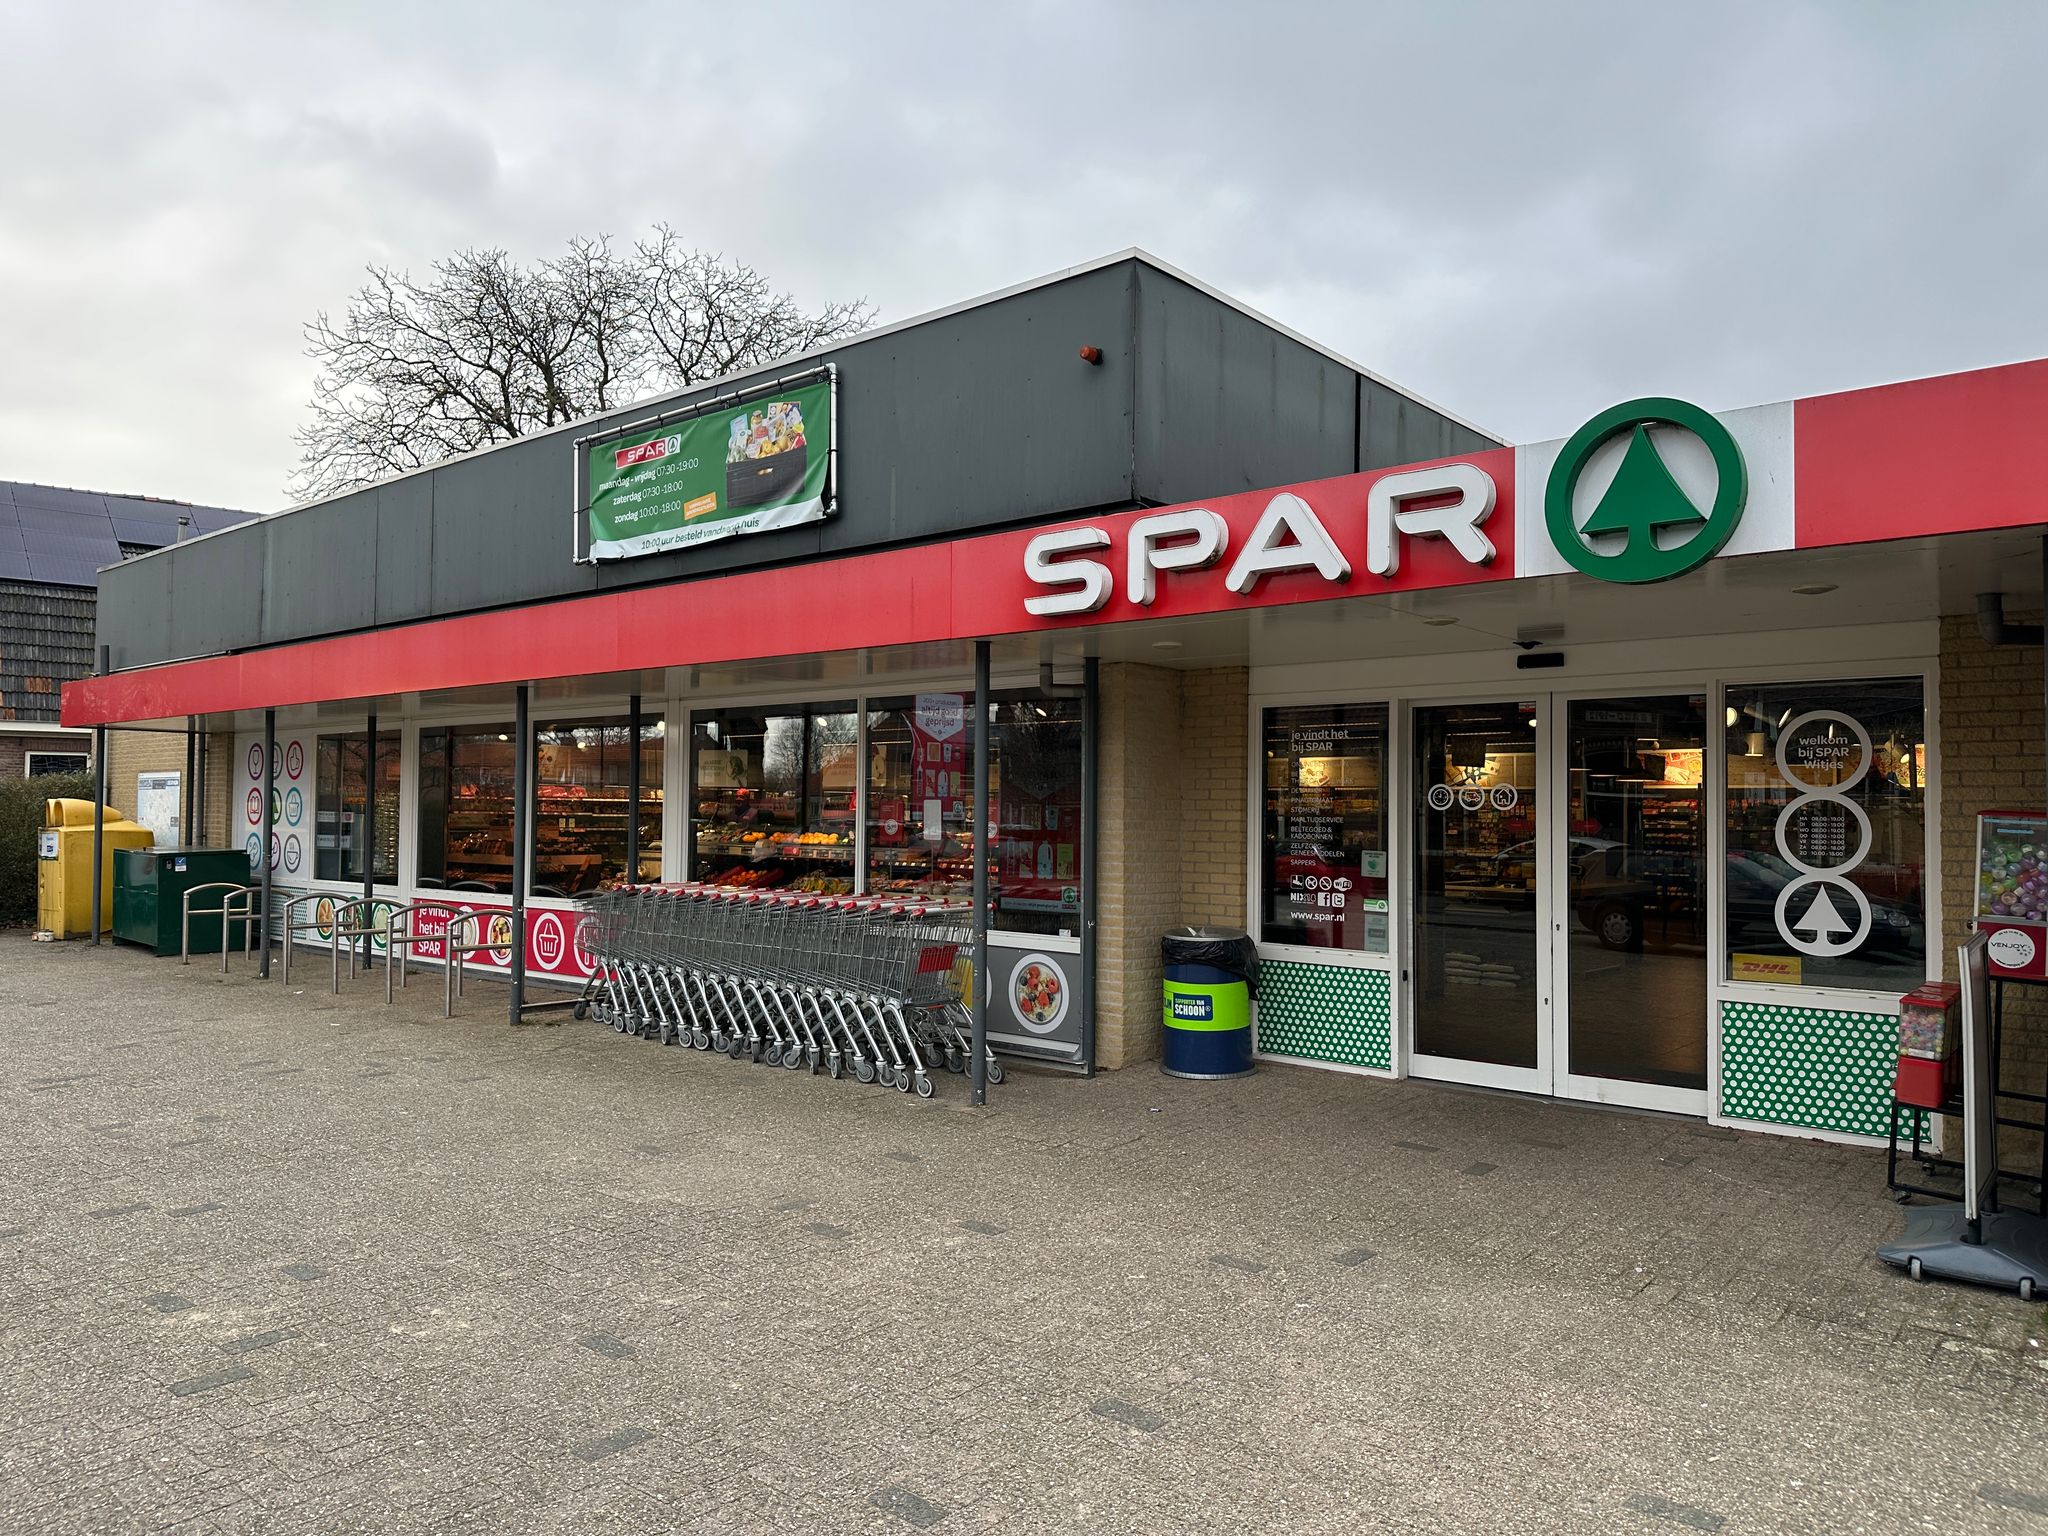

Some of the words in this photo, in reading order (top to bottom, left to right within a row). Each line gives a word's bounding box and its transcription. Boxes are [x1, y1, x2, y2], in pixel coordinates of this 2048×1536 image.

[627, 442, 665, 462] SPAR
[599, 477, 630, 491] maandag
[634, 468, 656, 484] vrijdag
[656, 463, 676, 477] 07:30
[613, 491, 642, 506] zaterdag
[642, 485, 661, 499] 07:30
[614, 510, 639, 524] zondag
[639, 505, 659, 519] 10:00
[641, 537, 660, 550] 10:00
[661, 536, 673, 545] uur
[675, 529, 703, 543] besteld
[1024, 463, 1497, 617] SPAR
[921, 705, 940, 717] altijd
[925, 717, 955, 728] geprijsd
[1290, 730, 1300, 742] je
[1302, 729, 1330, 740] vindt
[1331, 729, 1349, 739] het
[1799, 735, 1848, 745] welkom
[1291, 742, 1304, 753] bij
[1305, 742, 1333, 752] SPAR
[1798, 747, 1814, 759] bij
[1815, 747, 1849, 757] SPAR
[1804, 760, 1844, 771] Witjes
[1290, 859, 1317, 867] SAPPERS
[1290, 911, 1345, 922] www.spar.nl
[419, 920, 433, 935] het
[418, 940, 441, 955] SPAR
[1991, 941, 2027, 949] VENJOY
[1742, 962, 1791, 975] DHL
